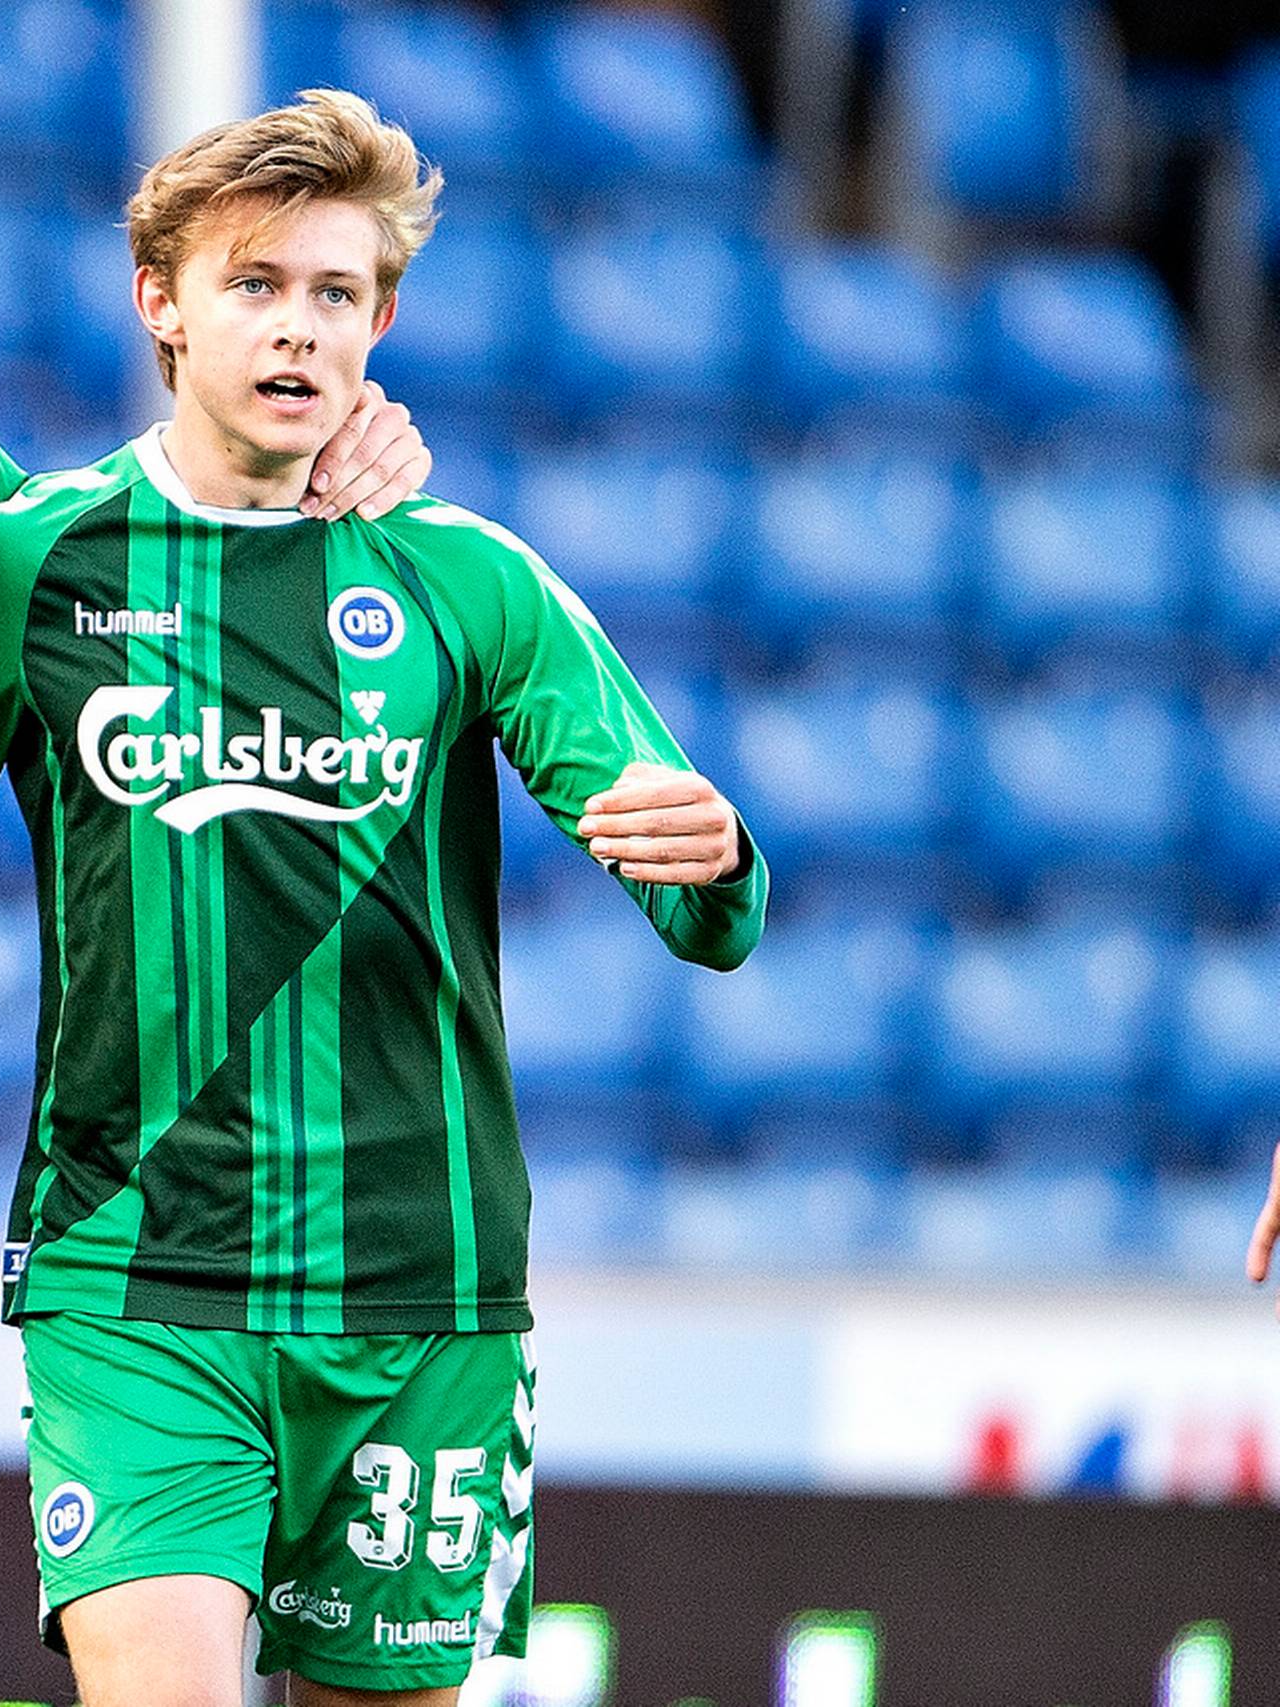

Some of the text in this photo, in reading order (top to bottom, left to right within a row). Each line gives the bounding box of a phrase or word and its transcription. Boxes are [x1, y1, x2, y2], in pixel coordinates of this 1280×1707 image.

[74, 600, 182, 635] hummel
[343, 609, 389, 636] OB
[76, 685, 424, 806] Carlsberg
[49, 1502, 81, 1537] OB
[347, 1442, 487, 1573] 35
[373, 1610, 471, 1645] hummel
